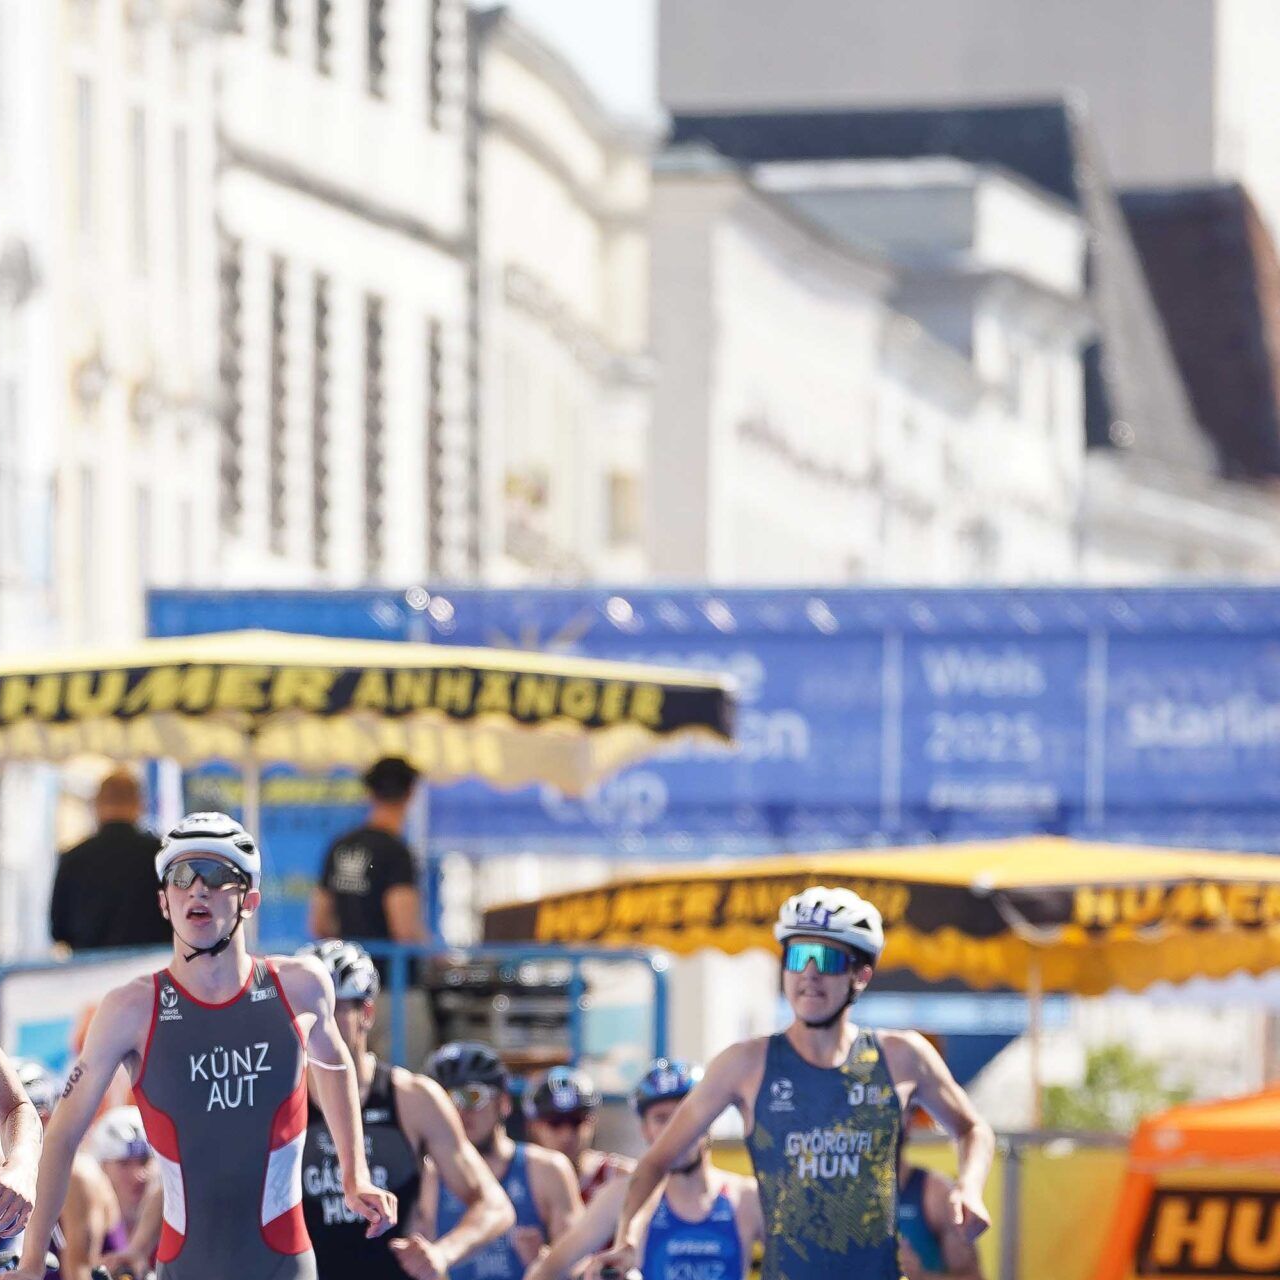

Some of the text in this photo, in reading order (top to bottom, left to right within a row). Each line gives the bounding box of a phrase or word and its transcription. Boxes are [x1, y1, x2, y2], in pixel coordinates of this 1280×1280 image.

[189, 1042, 272, 1082] KÜNZ
[207, 1074, 259, 1112] AUT
[798, 1154, 860, 1179] HUN
